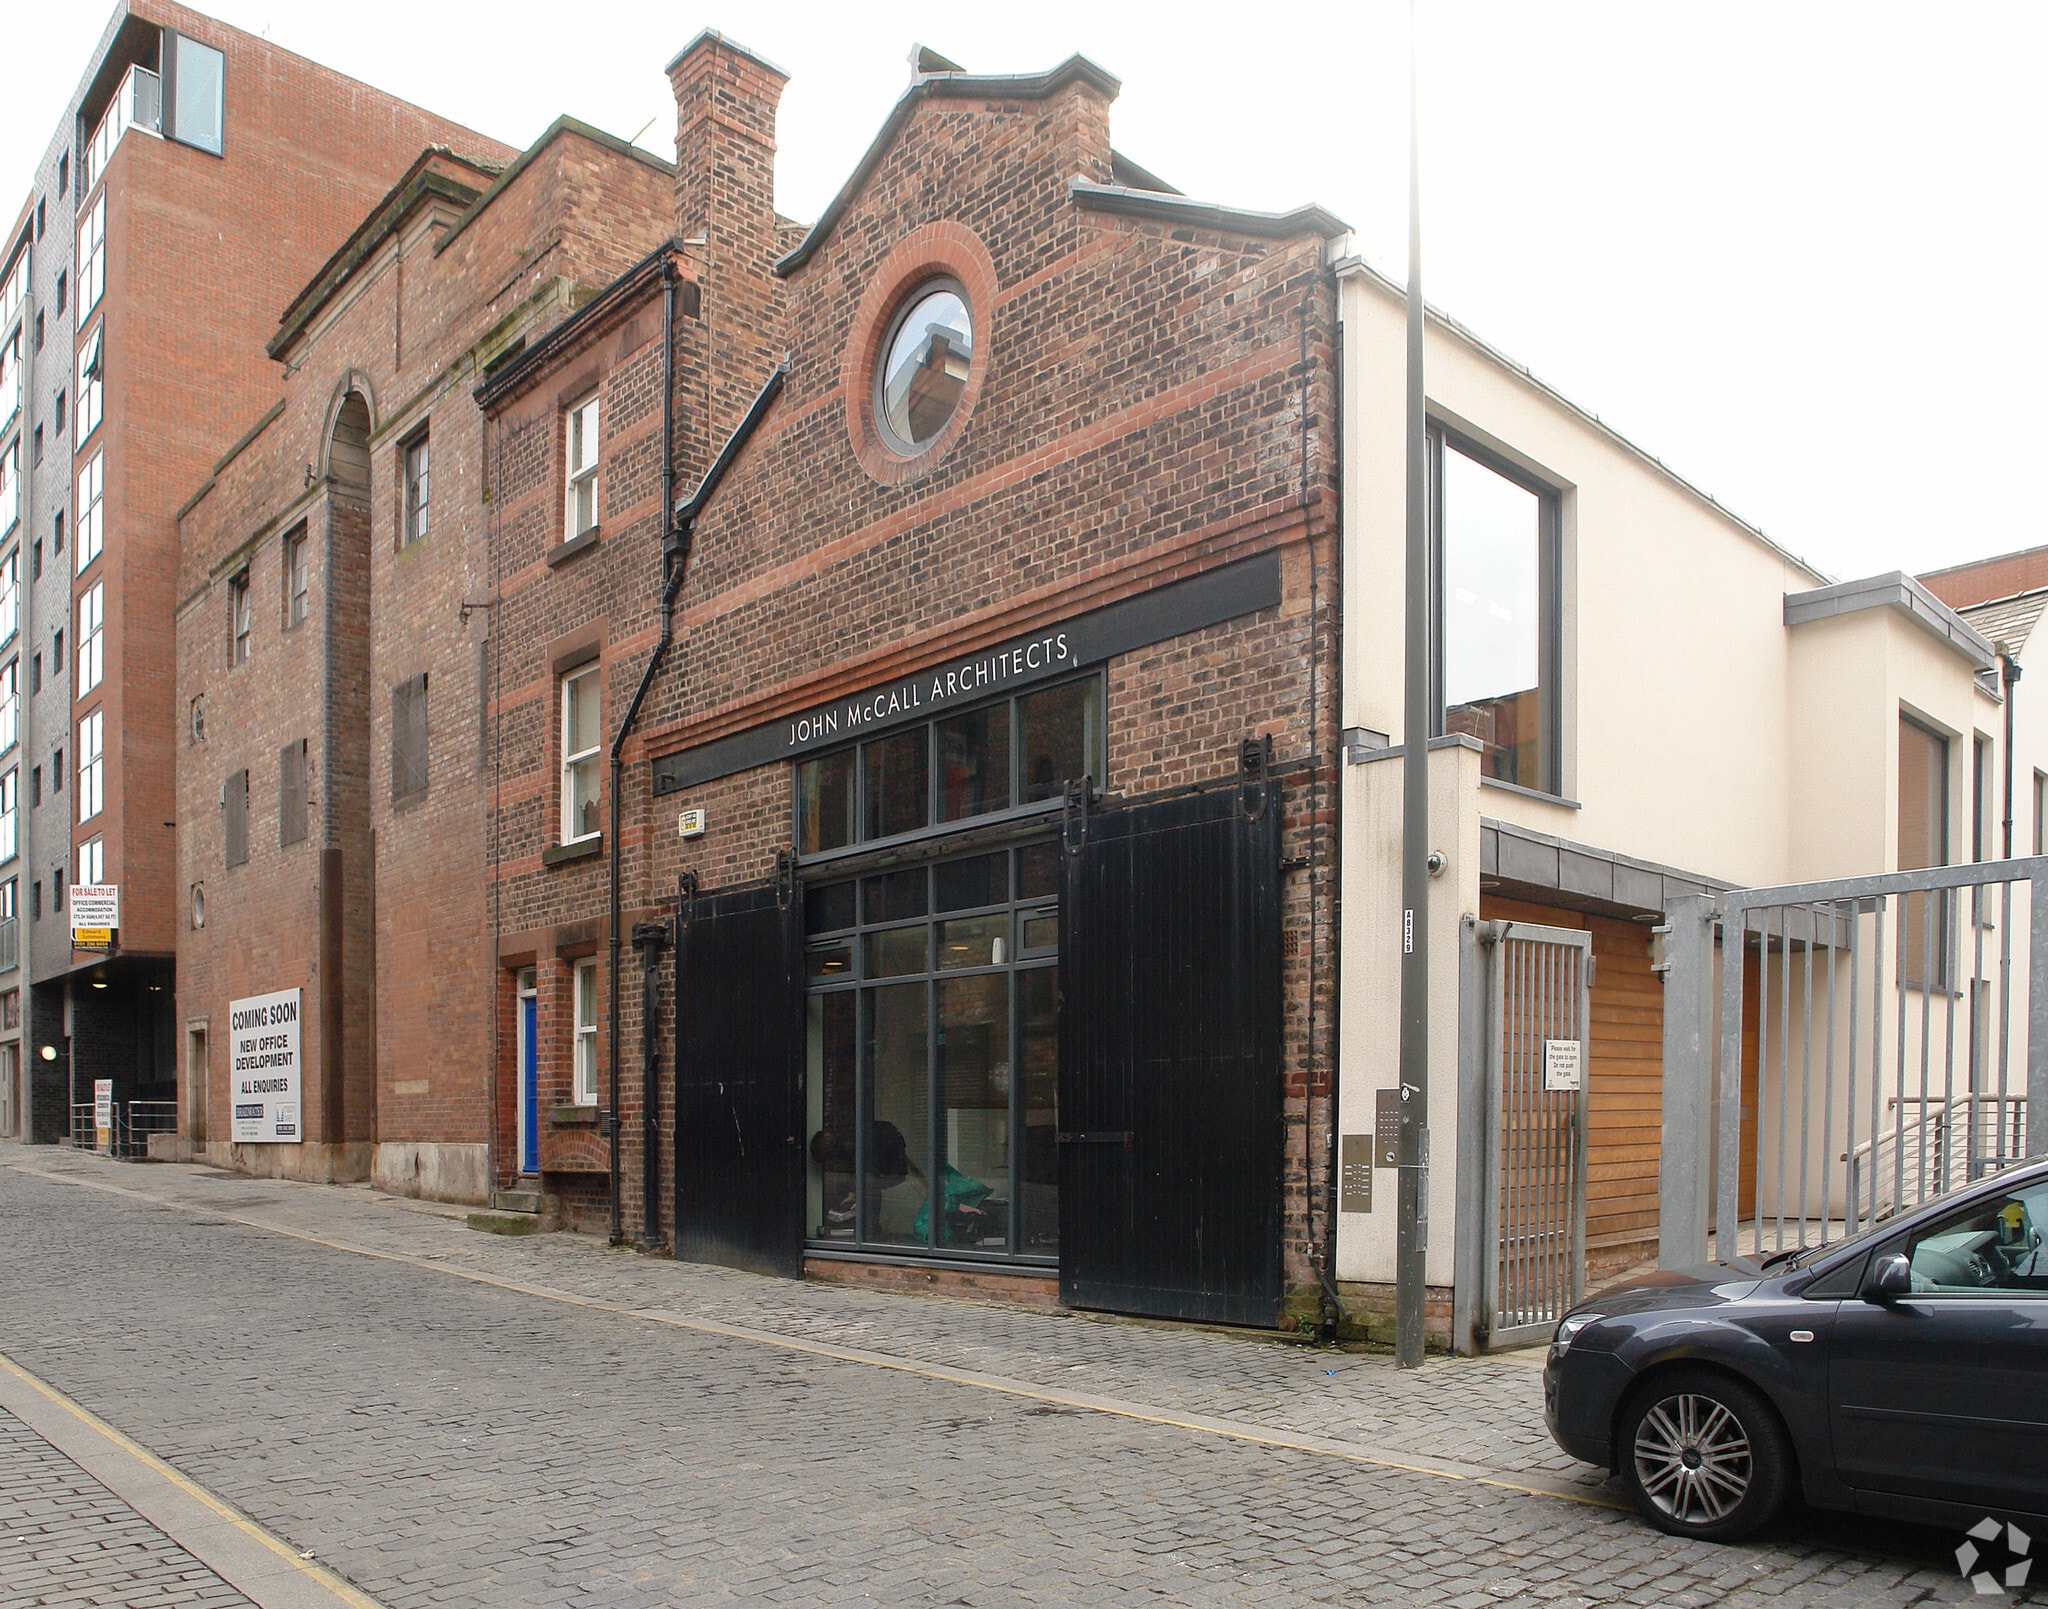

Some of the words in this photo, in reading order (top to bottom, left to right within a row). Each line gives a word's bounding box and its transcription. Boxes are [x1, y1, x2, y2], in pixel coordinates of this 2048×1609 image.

[789, 710, 838, 745] JOHN
[847, 684, 920, 728] McCALL
[930, 633, 1068, 701] ARCHITECTS
[72, 887, 83, 896] FOR
[106, 887, 116, 896] LET
[232, 1007, 268, 1031] COMING
[270, 1001, 297, 1025] SOON
[240, 1038, 257, 1053] NEW
[259, 1034, 288, 1051] OFFICE
[236, 1052, 293, 1071] DEVELOPMENT
[241, 1081, 252, 1094] ALL
[253, 1078, 288, 1093] ENQUIRIES
